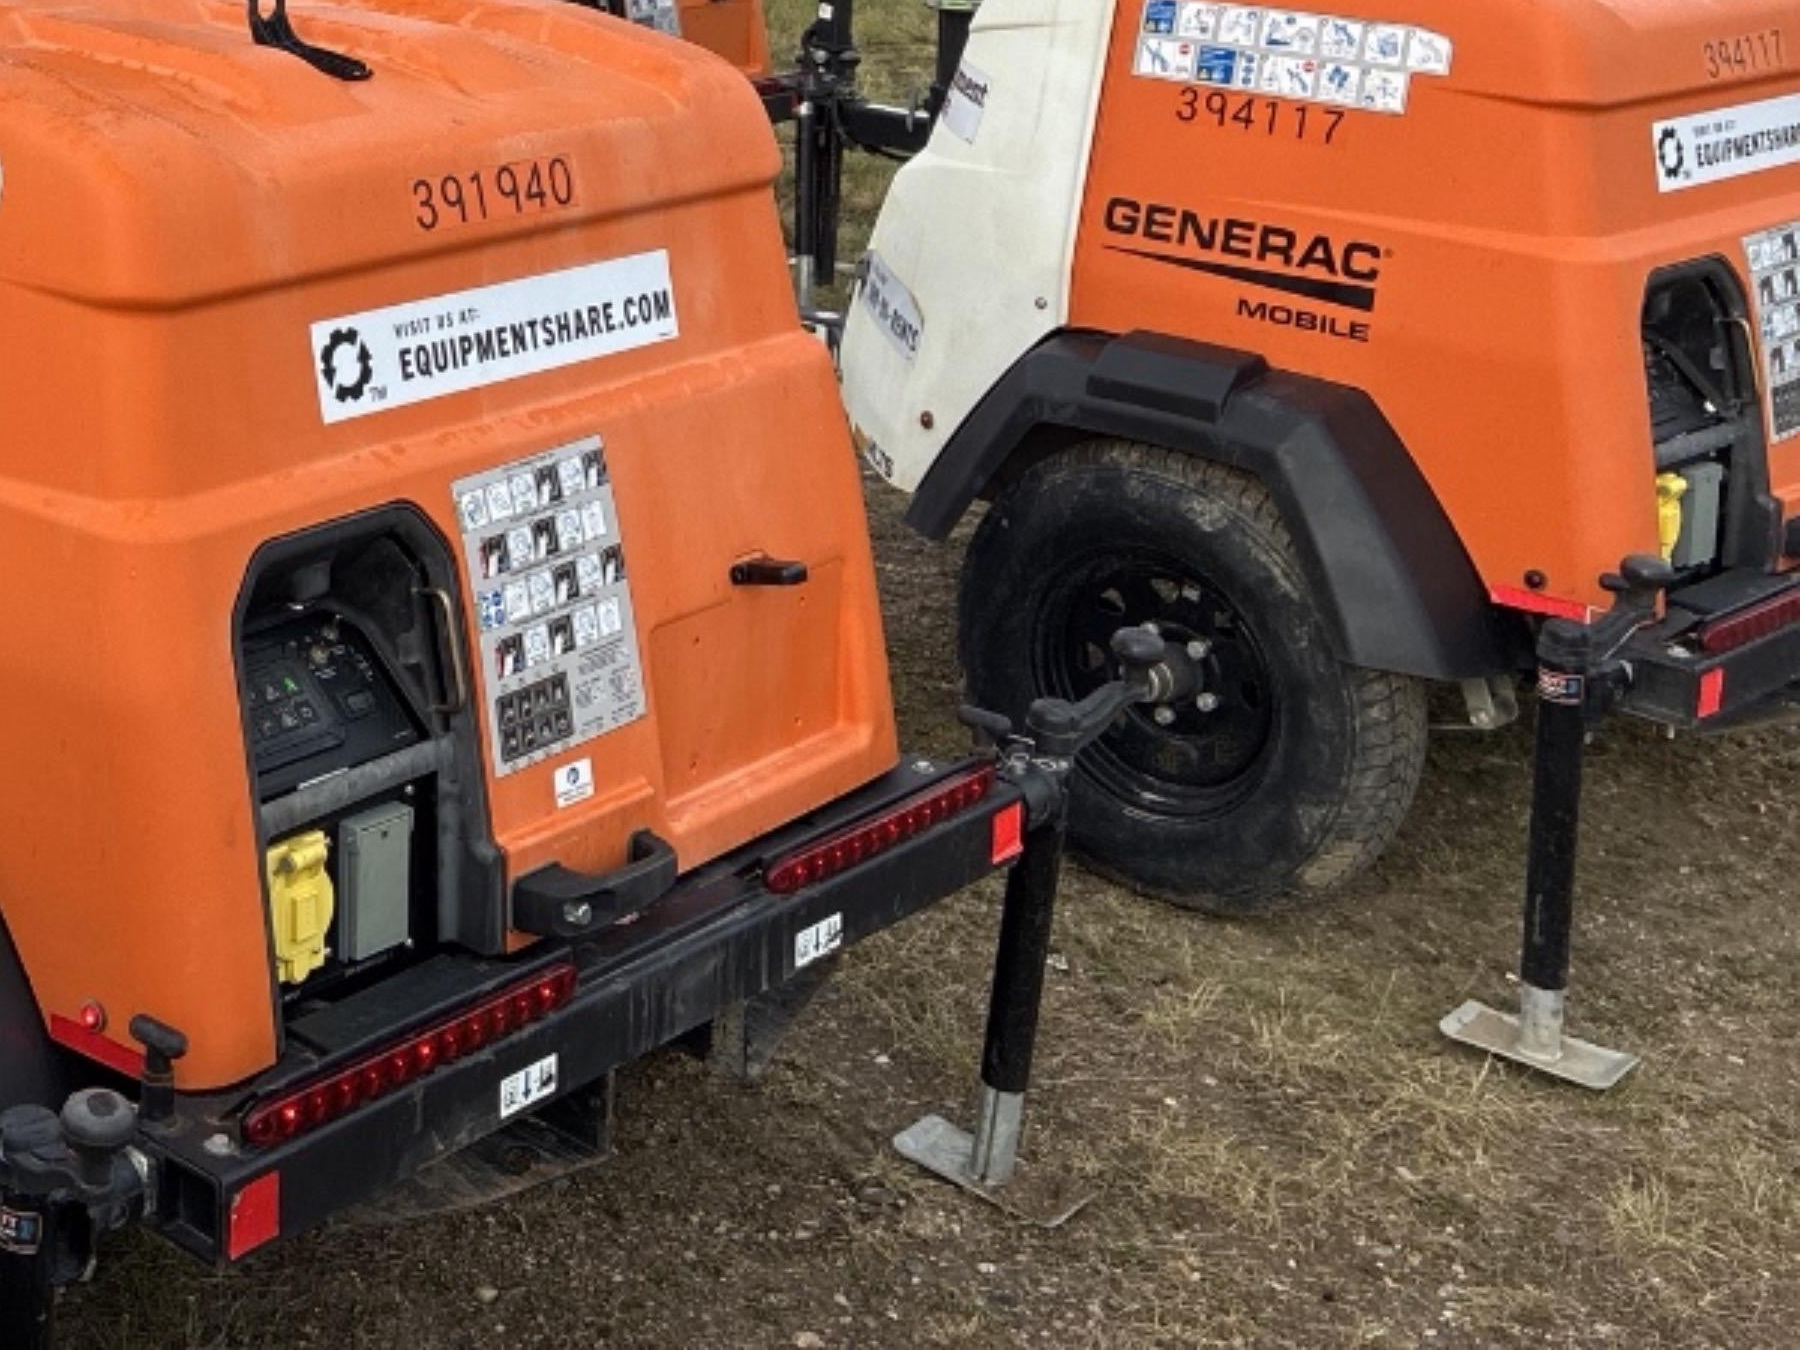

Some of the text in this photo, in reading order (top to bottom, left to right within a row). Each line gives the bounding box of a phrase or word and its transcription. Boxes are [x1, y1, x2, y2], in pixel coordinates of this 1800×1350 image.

[1703, 29, 1784, 79] 394117
[1175, 86, 1345, 144] 394117
[412, 157, 572, 231] 391940
[1103, 197, 1381, 282] GENERAC
[398, 289, 671, 381] EQUIPMENTSHARE.COM
[1235, 297, 1371, 342] MOBILE
